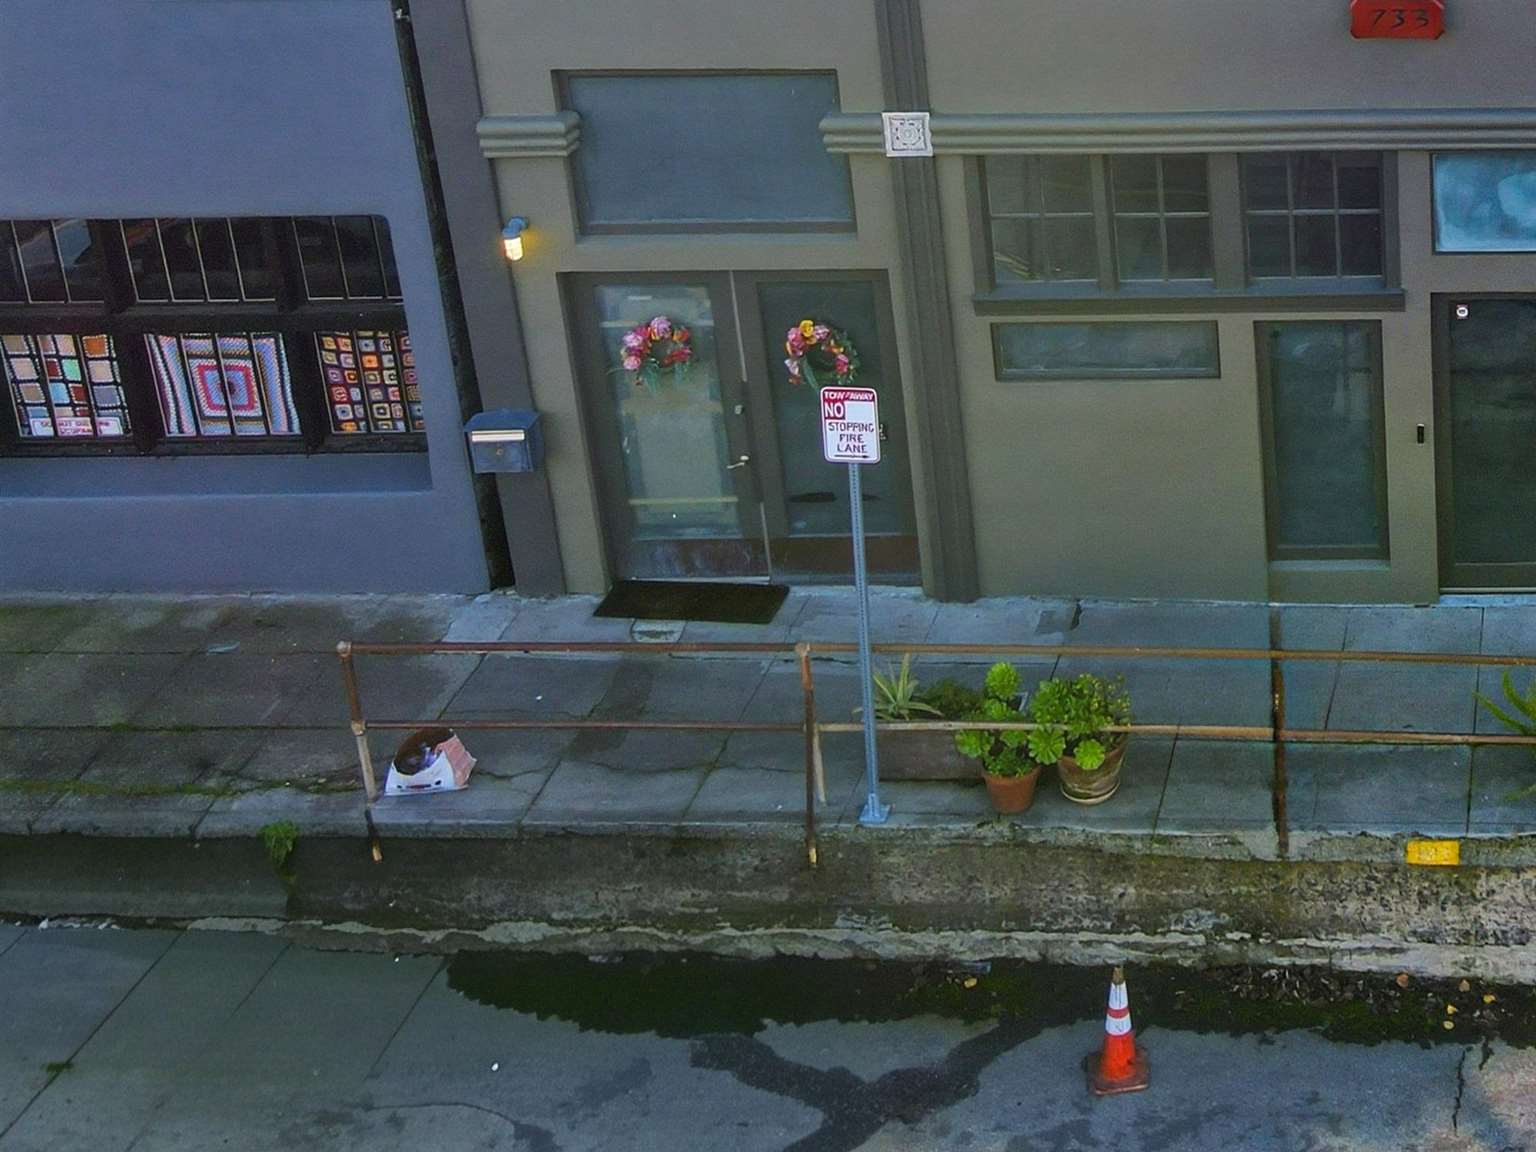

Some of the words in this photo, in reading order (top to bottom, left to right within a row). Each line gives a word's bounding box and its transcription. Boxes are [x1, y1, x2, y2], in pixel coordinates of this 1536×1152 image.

[1369, 9, 1430, 30] 733
[824, 401, 844, 418] NO
[828, 422, 875, 432] STOPPING
[840, 434, 864, 443] FIRE
[837, 444, 868, 453] LANE
